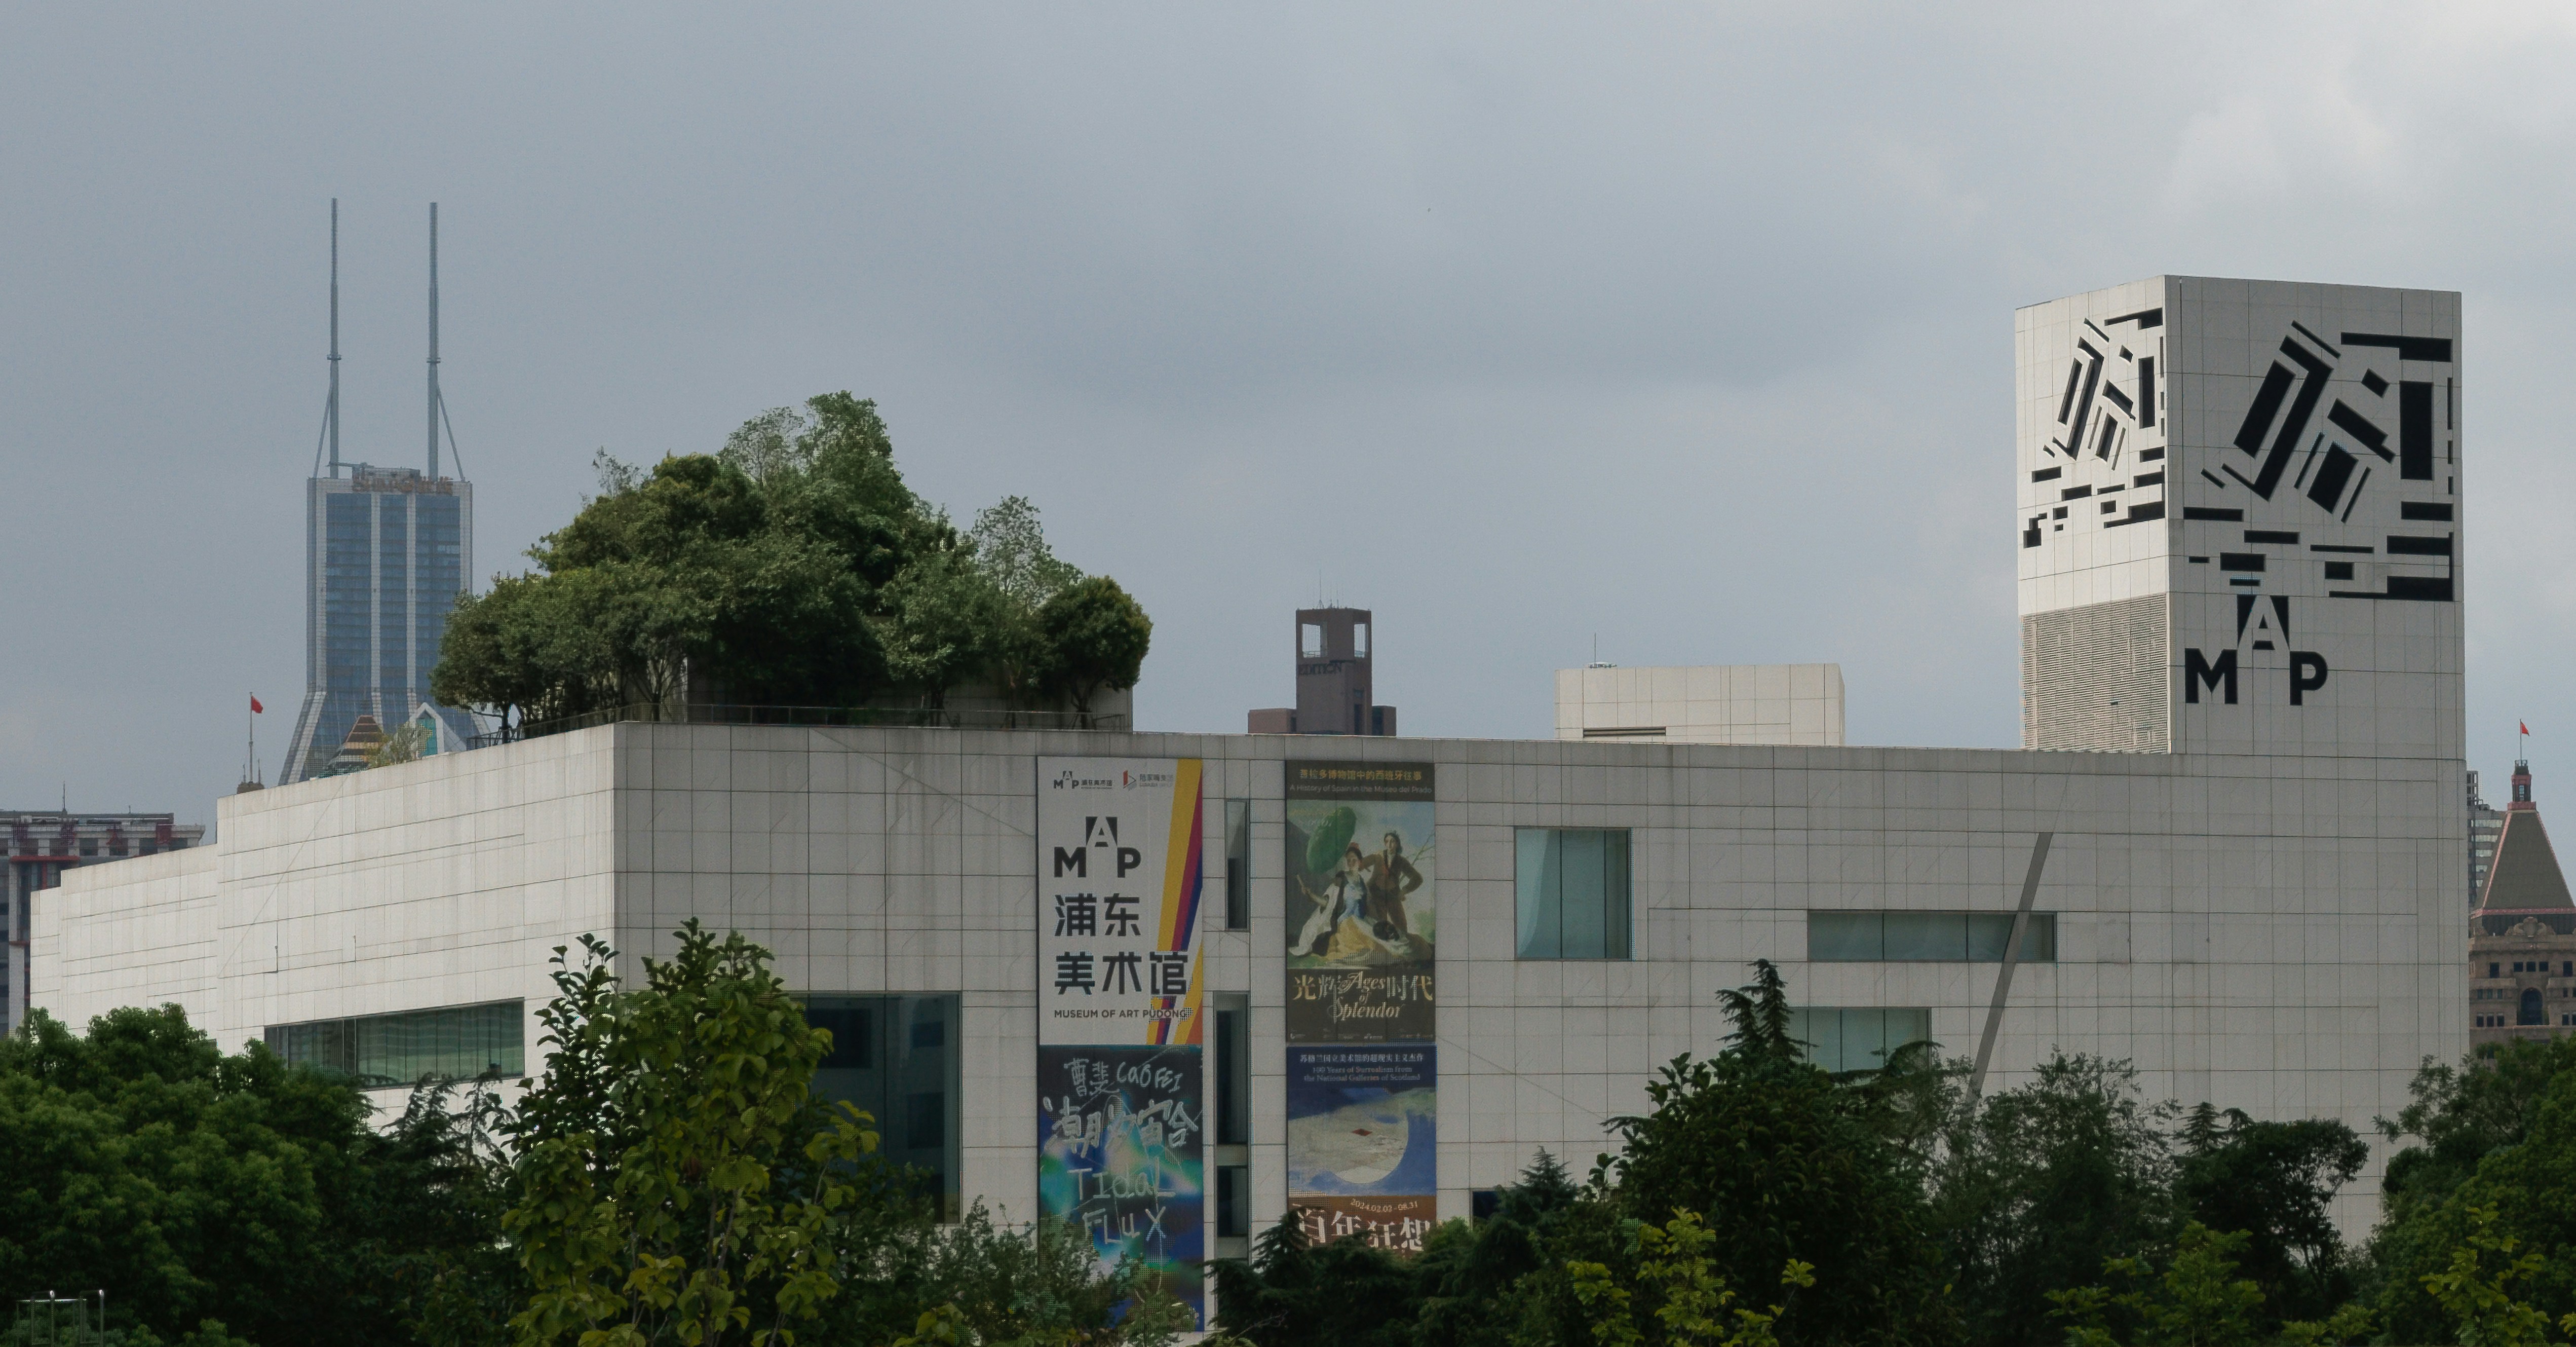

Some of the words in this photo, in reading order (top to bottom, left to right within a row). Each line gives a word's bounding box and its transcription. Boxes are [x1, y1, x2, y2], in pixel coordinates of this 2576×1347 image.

[2185, 594, 2328, 705] MAP
[1297, 785, 1322, 793] History
[1054, 816, 1141, 878] MAP
[1054, 893, 1141, 937] 浦东
[1054, 951, 1188, 995] 美术馆
[1337, 970, 1386, 994] Ages
[1054, 1009, 1098, 1018] MUSEUM
[1101, 1009, 1116, 1018] OF
[1119, 1009, 1138, 1018] ART
[1143, 1009, 1186, 1018] PUDONG
[1327, 996, 1406, 1021] Splendor
